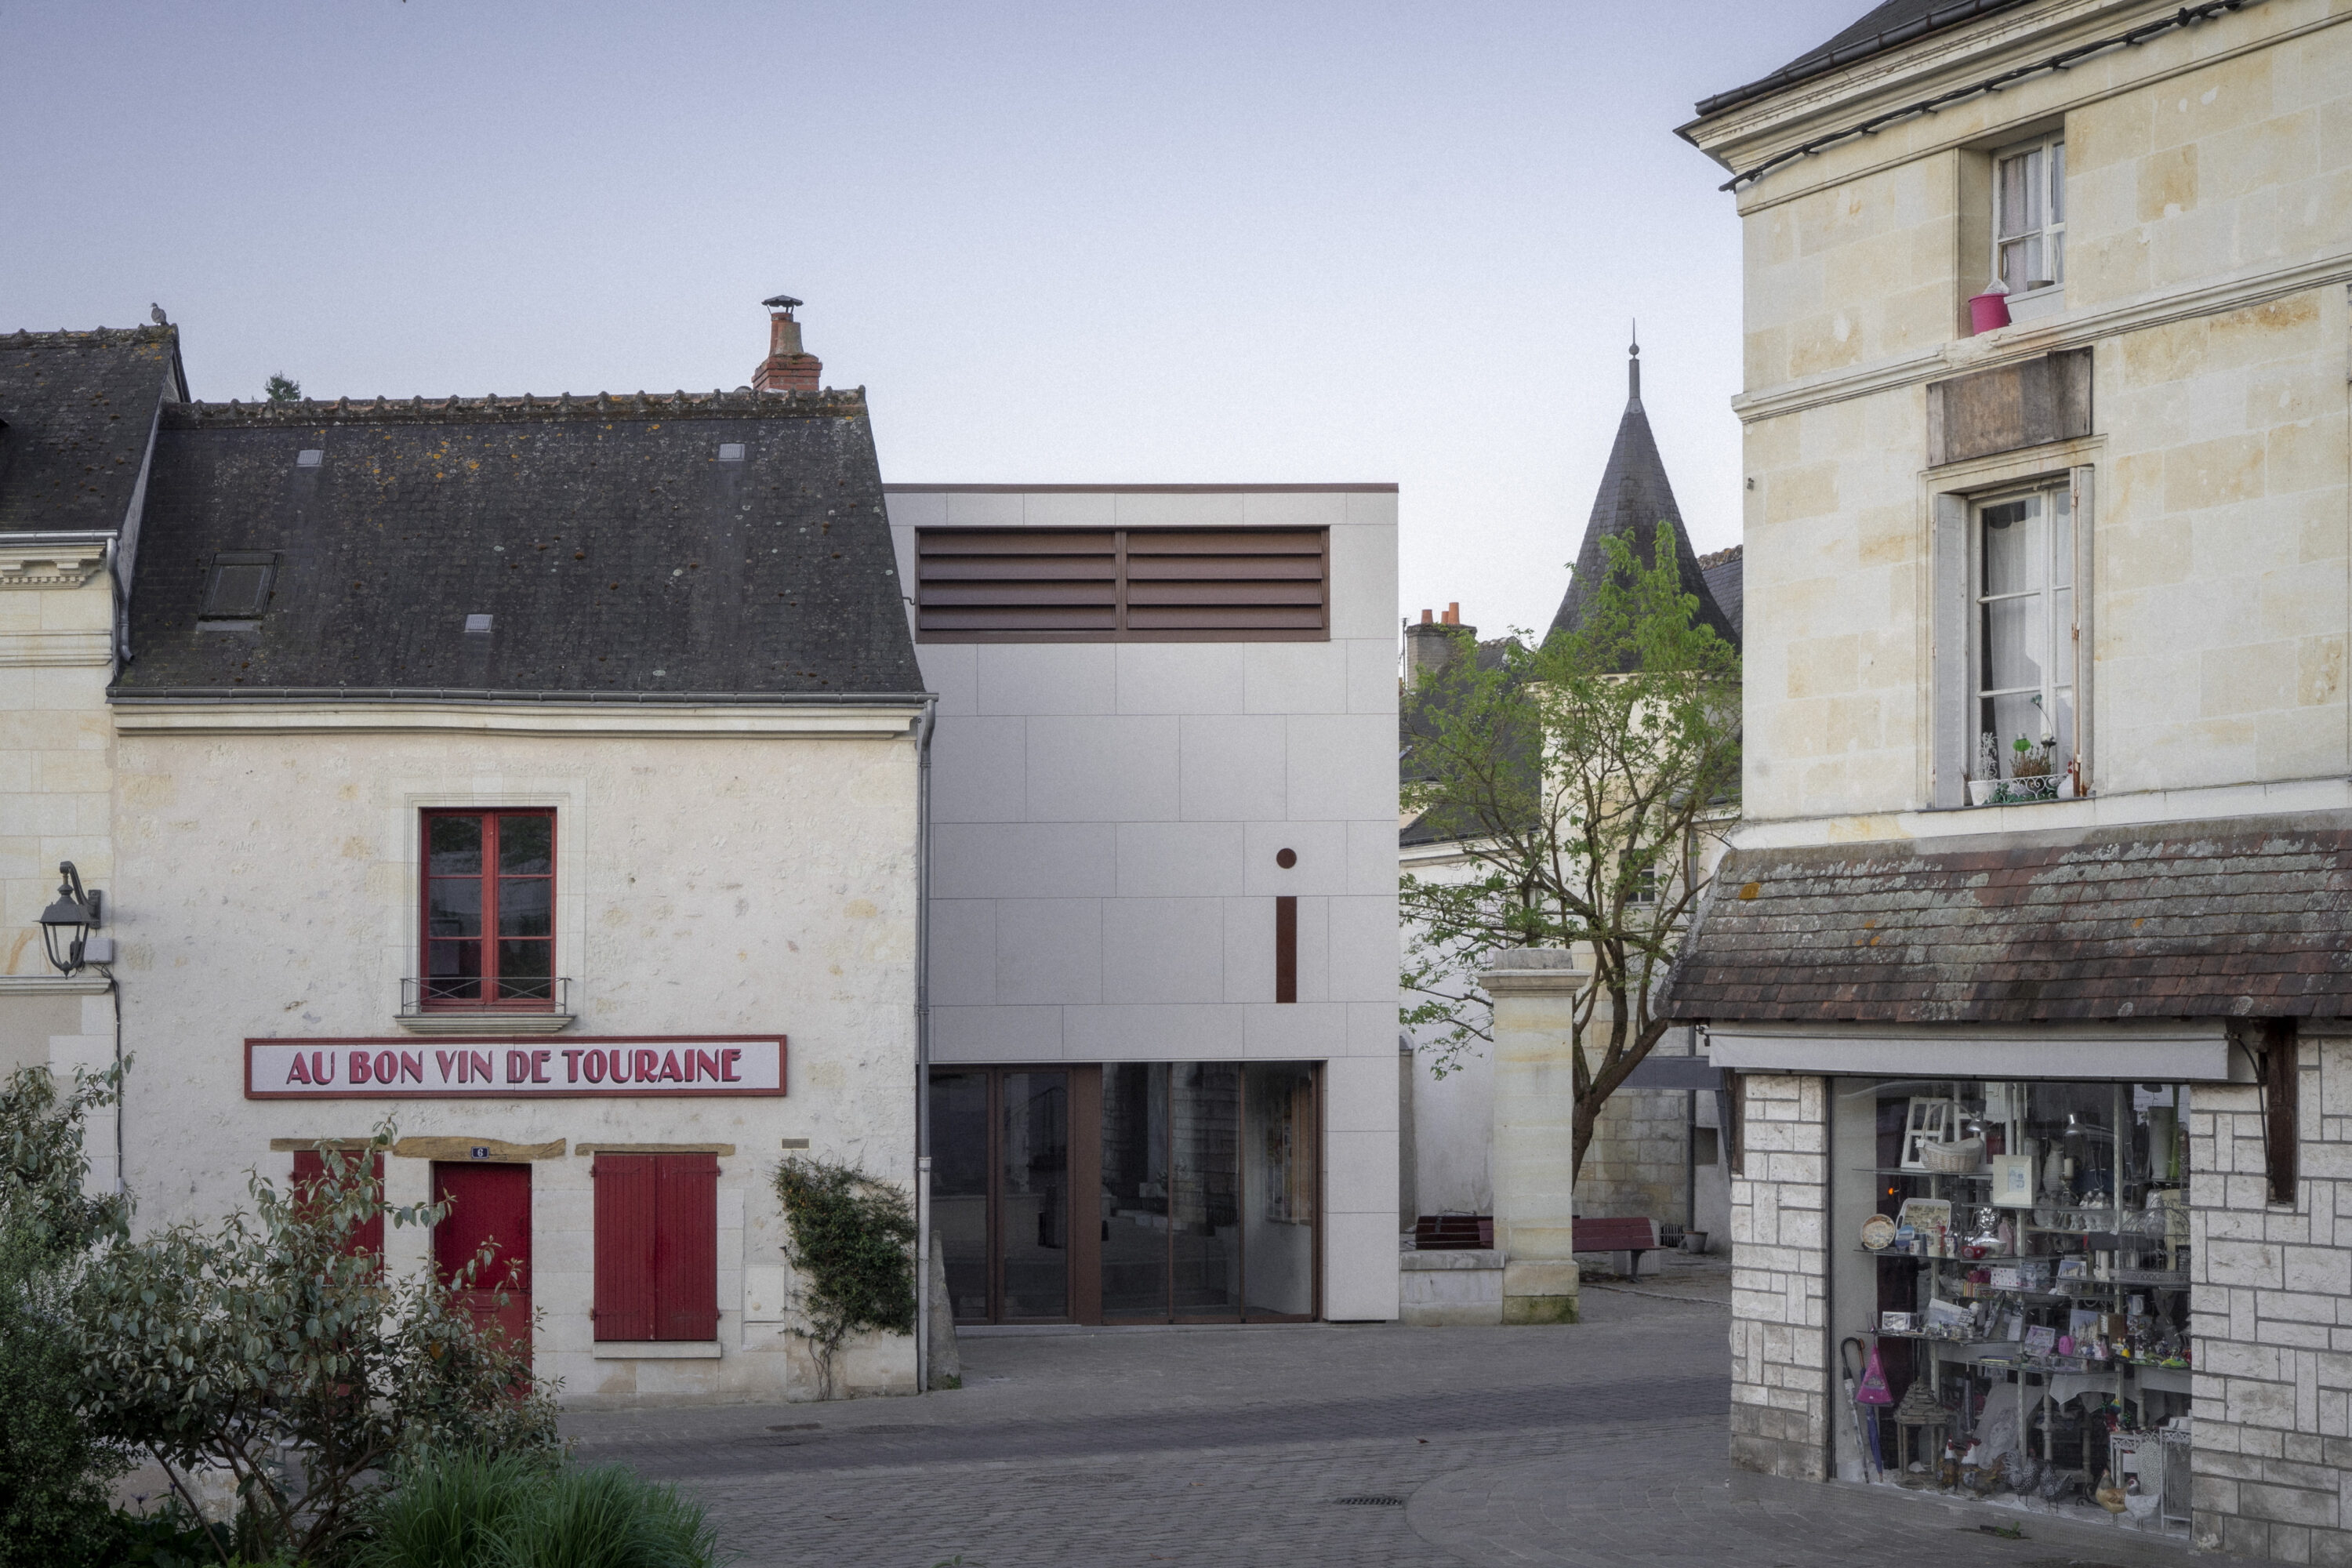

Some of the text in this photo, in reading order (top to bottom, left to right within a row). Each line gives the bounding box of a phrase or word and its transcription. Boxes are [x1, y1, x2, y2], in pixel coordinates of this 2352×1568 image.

[286, 1048, 742, 1085] AU BON VIN DE TOURAINE
[477, 1148, 484, 1157] 6
